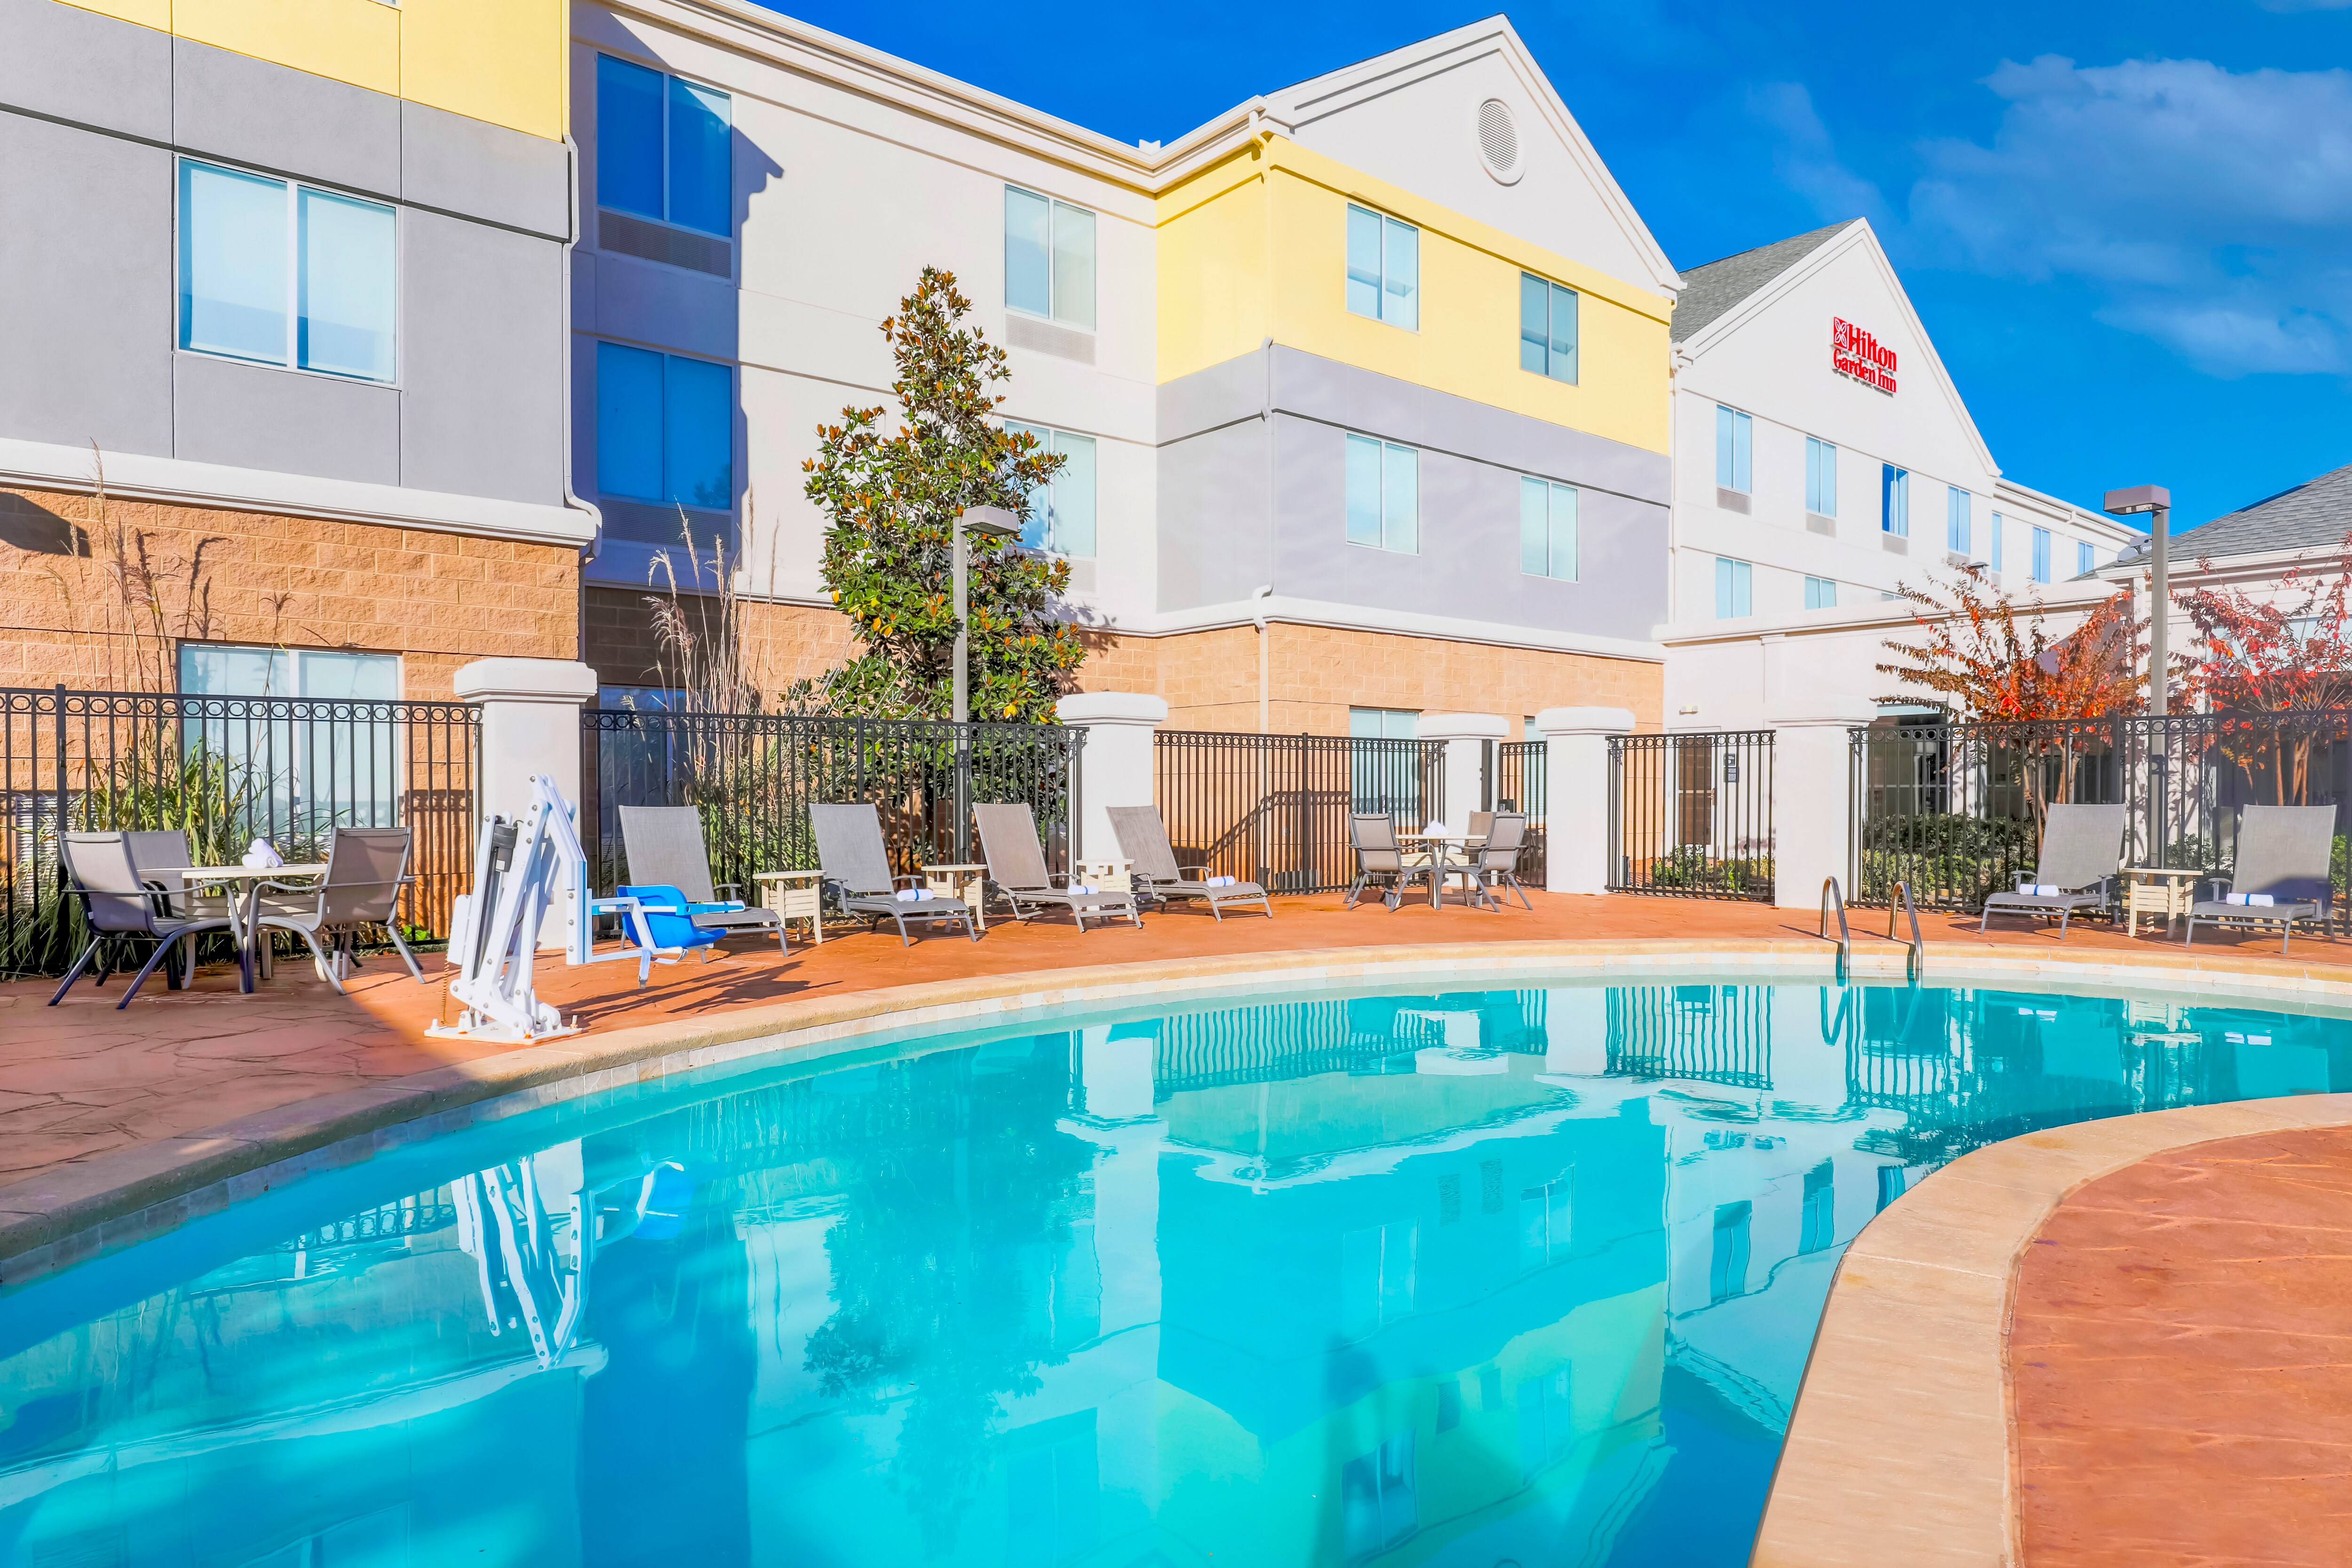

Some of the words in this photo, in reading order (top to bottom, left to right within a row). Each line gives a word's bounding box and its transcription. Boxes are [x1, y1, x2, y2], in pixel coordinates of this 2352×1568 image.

[1834, 348, 1876, 384] Garden
[1877, 367, 1896, 392] Inn
[1847, 324, 1897, 372] Hilton
